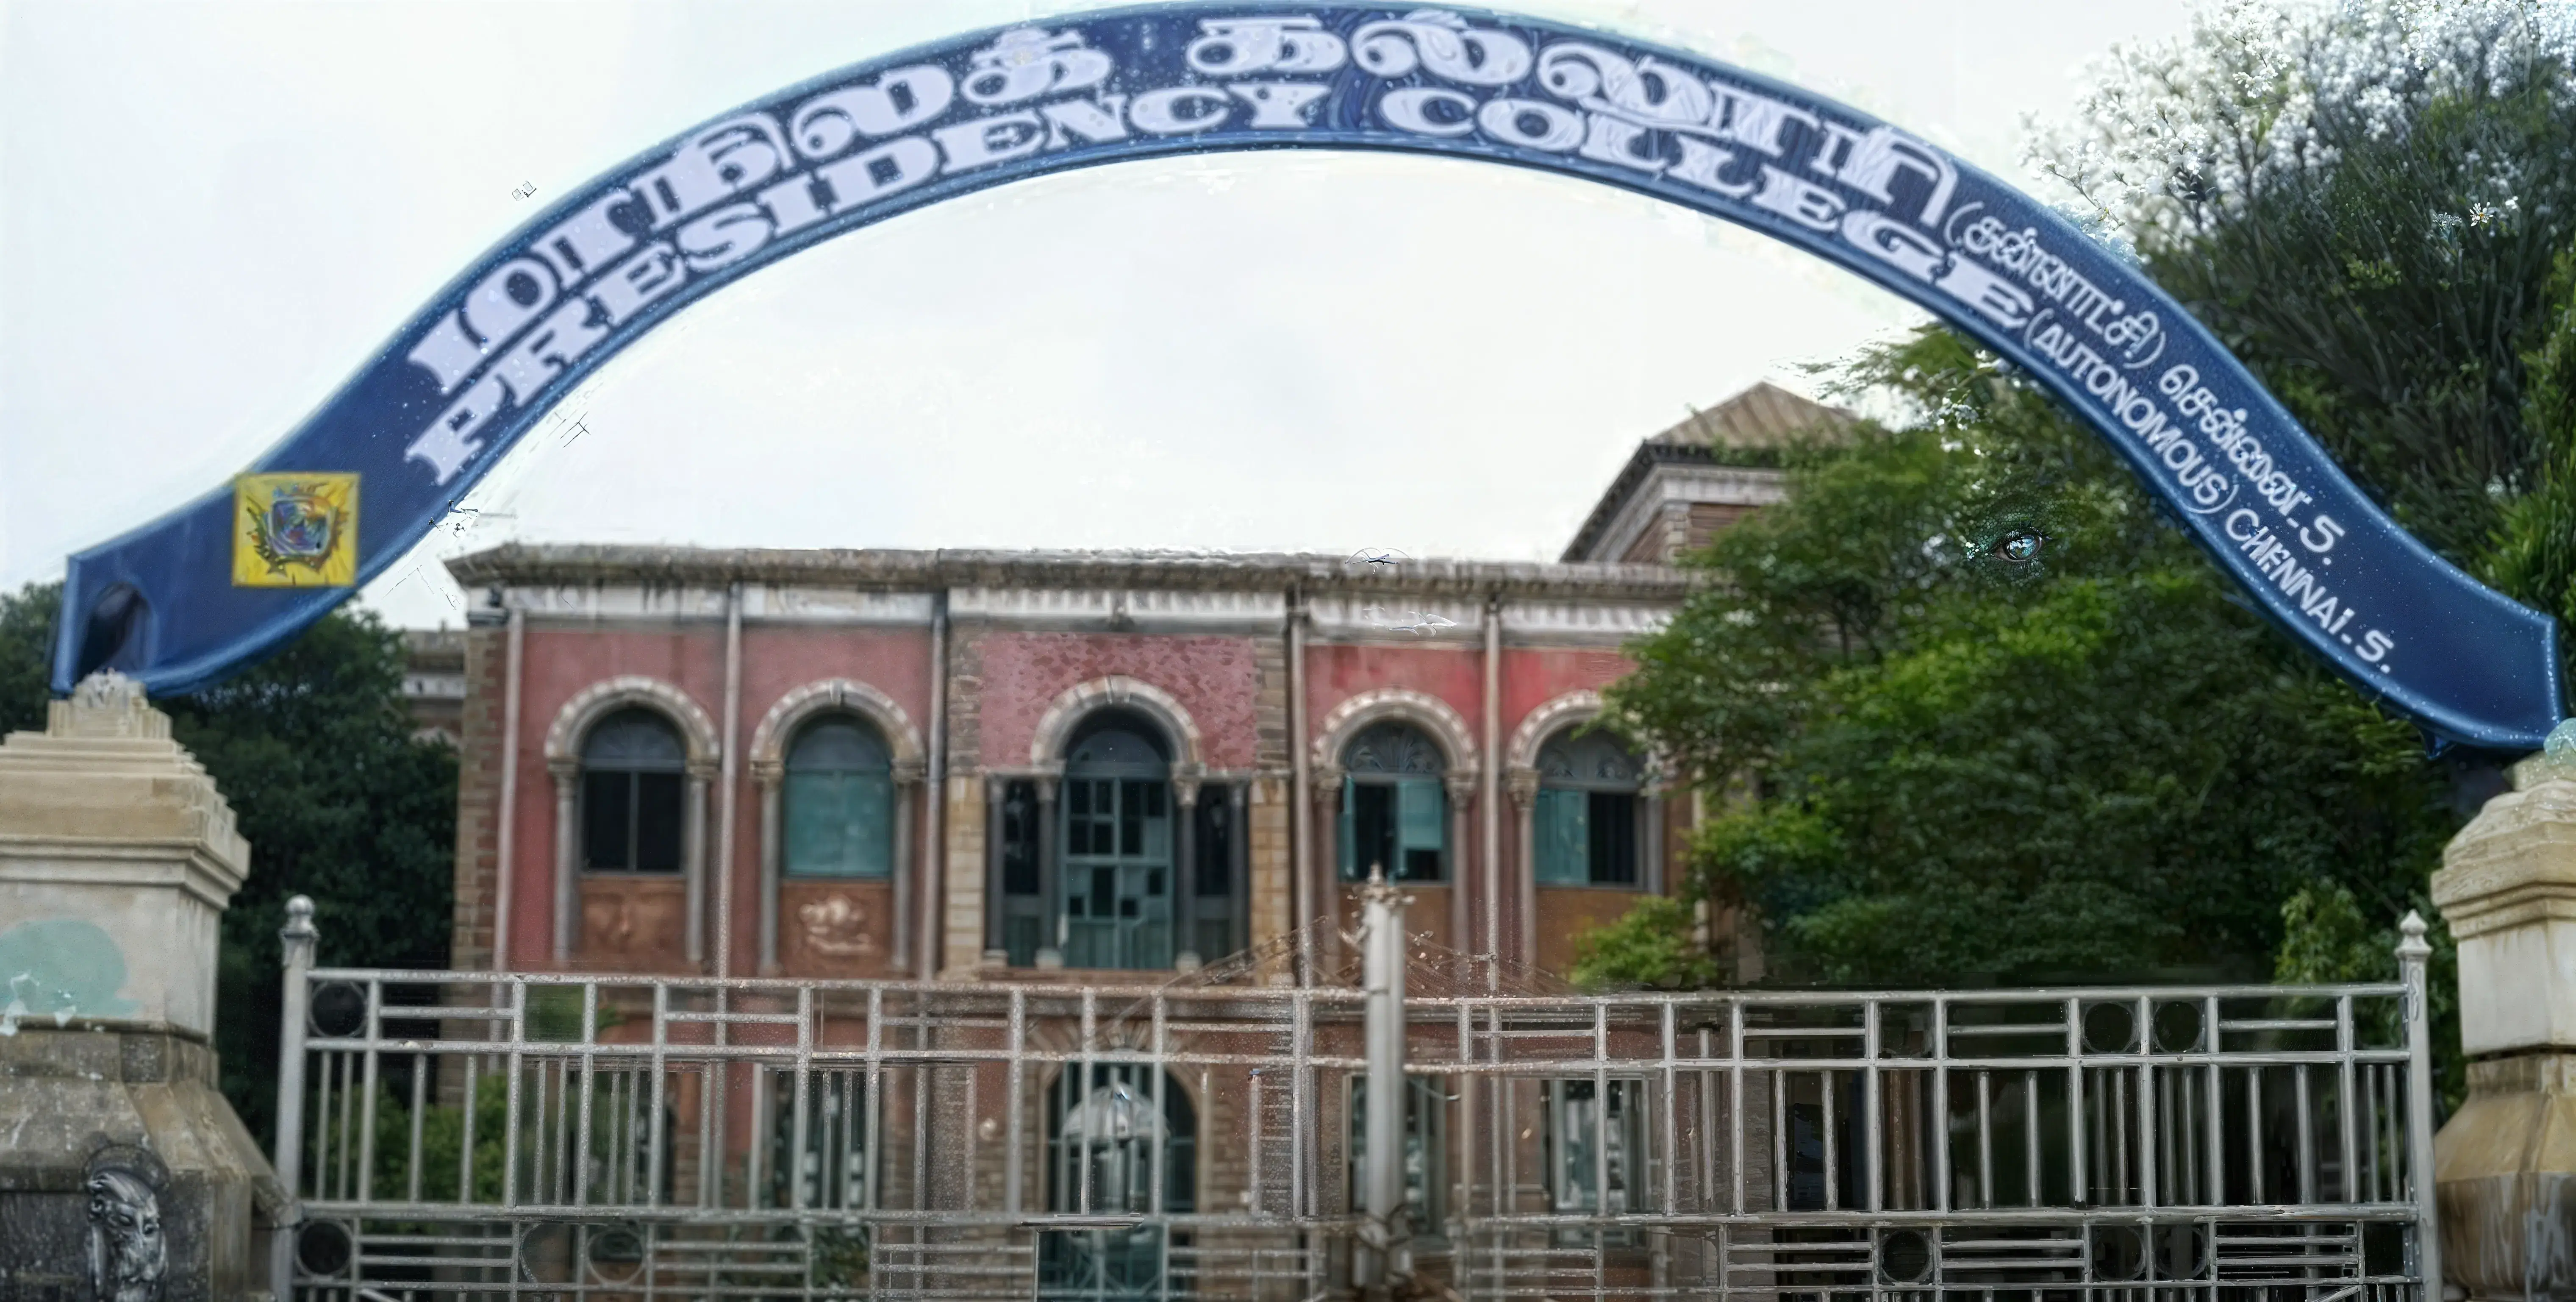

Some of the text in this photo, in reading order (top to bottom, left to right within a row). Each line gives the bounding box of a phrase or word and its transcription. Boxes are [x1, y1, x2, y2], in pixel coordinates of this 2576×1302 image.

[404, 83, 1332, 485] PRESIDENCY
[1380, 87, 2035, 329] COLLEGE
[2024, 307, 2240, 514] (AUTONOMOUS)
